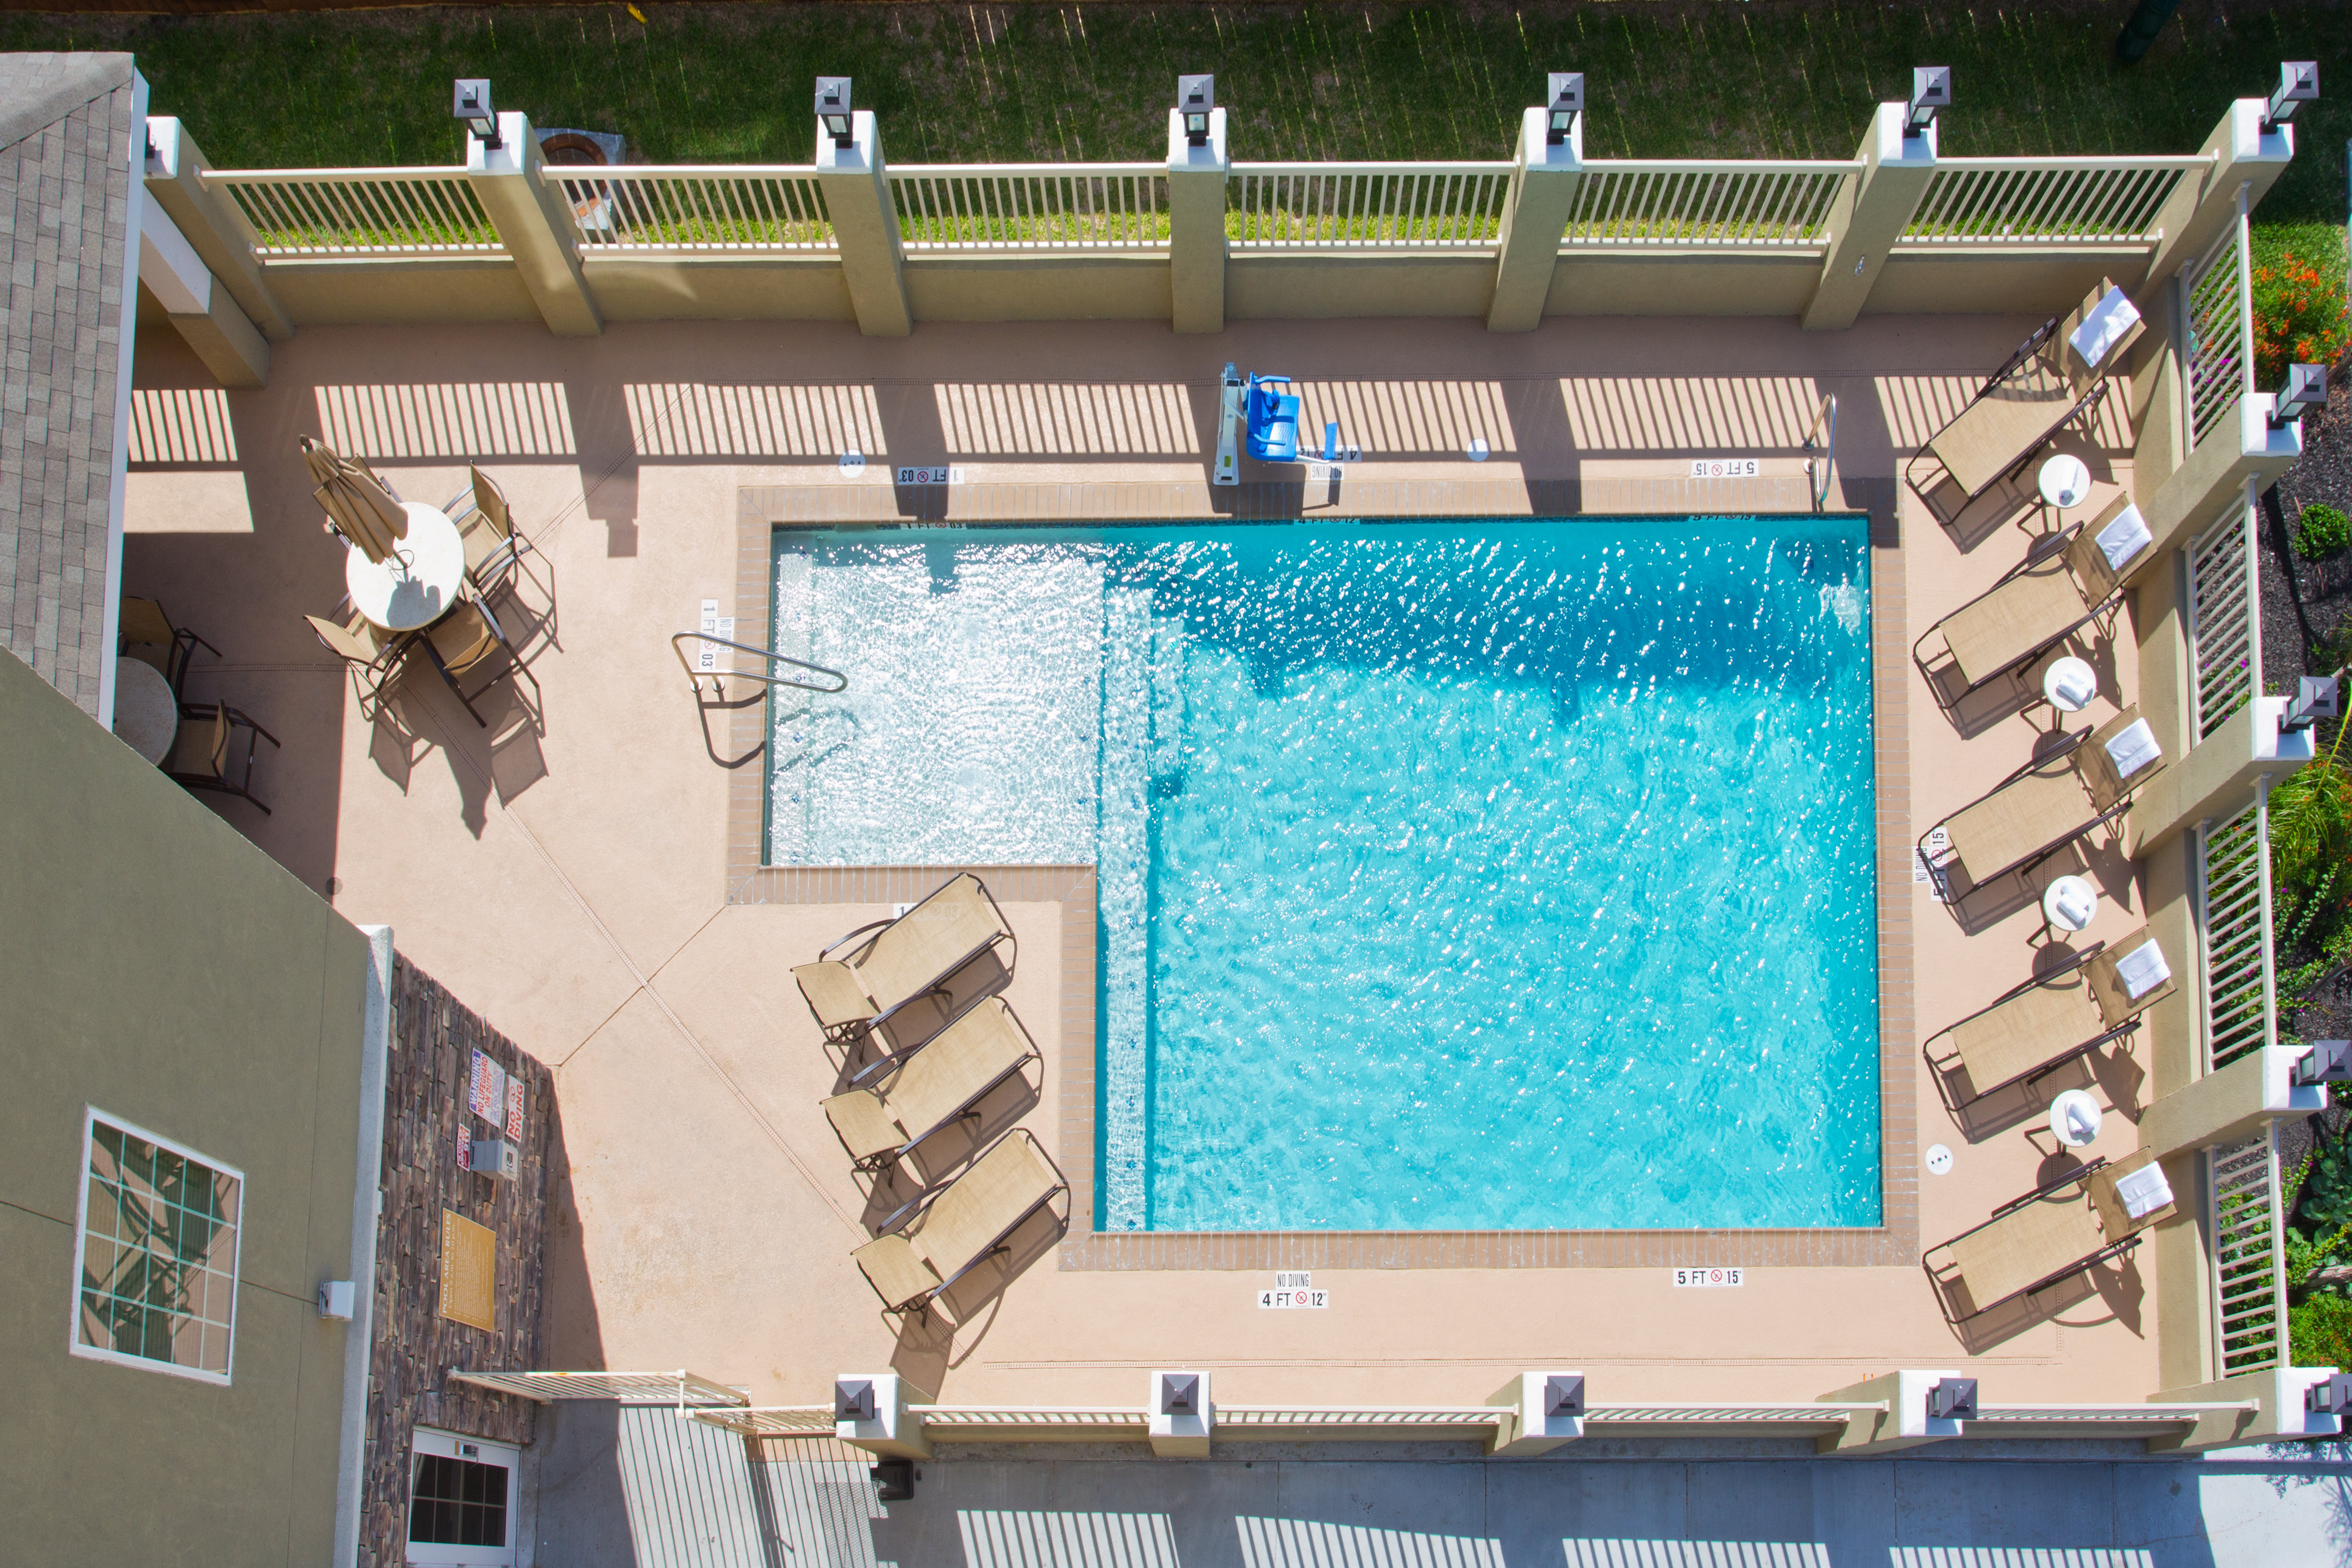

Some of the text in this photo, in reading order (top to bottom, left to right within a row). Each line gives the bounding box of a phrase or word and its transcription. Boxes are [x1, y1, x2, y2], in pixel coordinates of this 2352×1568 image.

[1332, 448, 1343, 460] F
[1349, 448, 1357, 460] 4
[1312, 466, 1342, 478] NO DIVING
[1727, 462, 1740, 474] FT
[1747, 462, 1754, 474] 5
[933, 470, 946, 482] FT
[954, 470, 958, 482] 1
[703, 619, 715, 633] FT
[719, 619, 731, 652] NO DIVG
[1916, 873, 1927, 881] NO
[900, 906, 904, 916] 1
[470, 1057, 481, 1105] WARNING
[477, 1056, 488, 1114] NO LIFEGUARD
[485, 1095, 491, 1107] ON
[508, 1084, 523, 1140] NO DIVING
[451, 1241, 454, 1249] 10
[1278, 1274, 1309, 1287] NO DIVING
[1678, 1271, 1686, 1284] 5
[1692, 1271, 1706, 1284] FT
[1263, 1293, 1271, 1306] 4
[1277, 1293, 1291, 1306] FT
